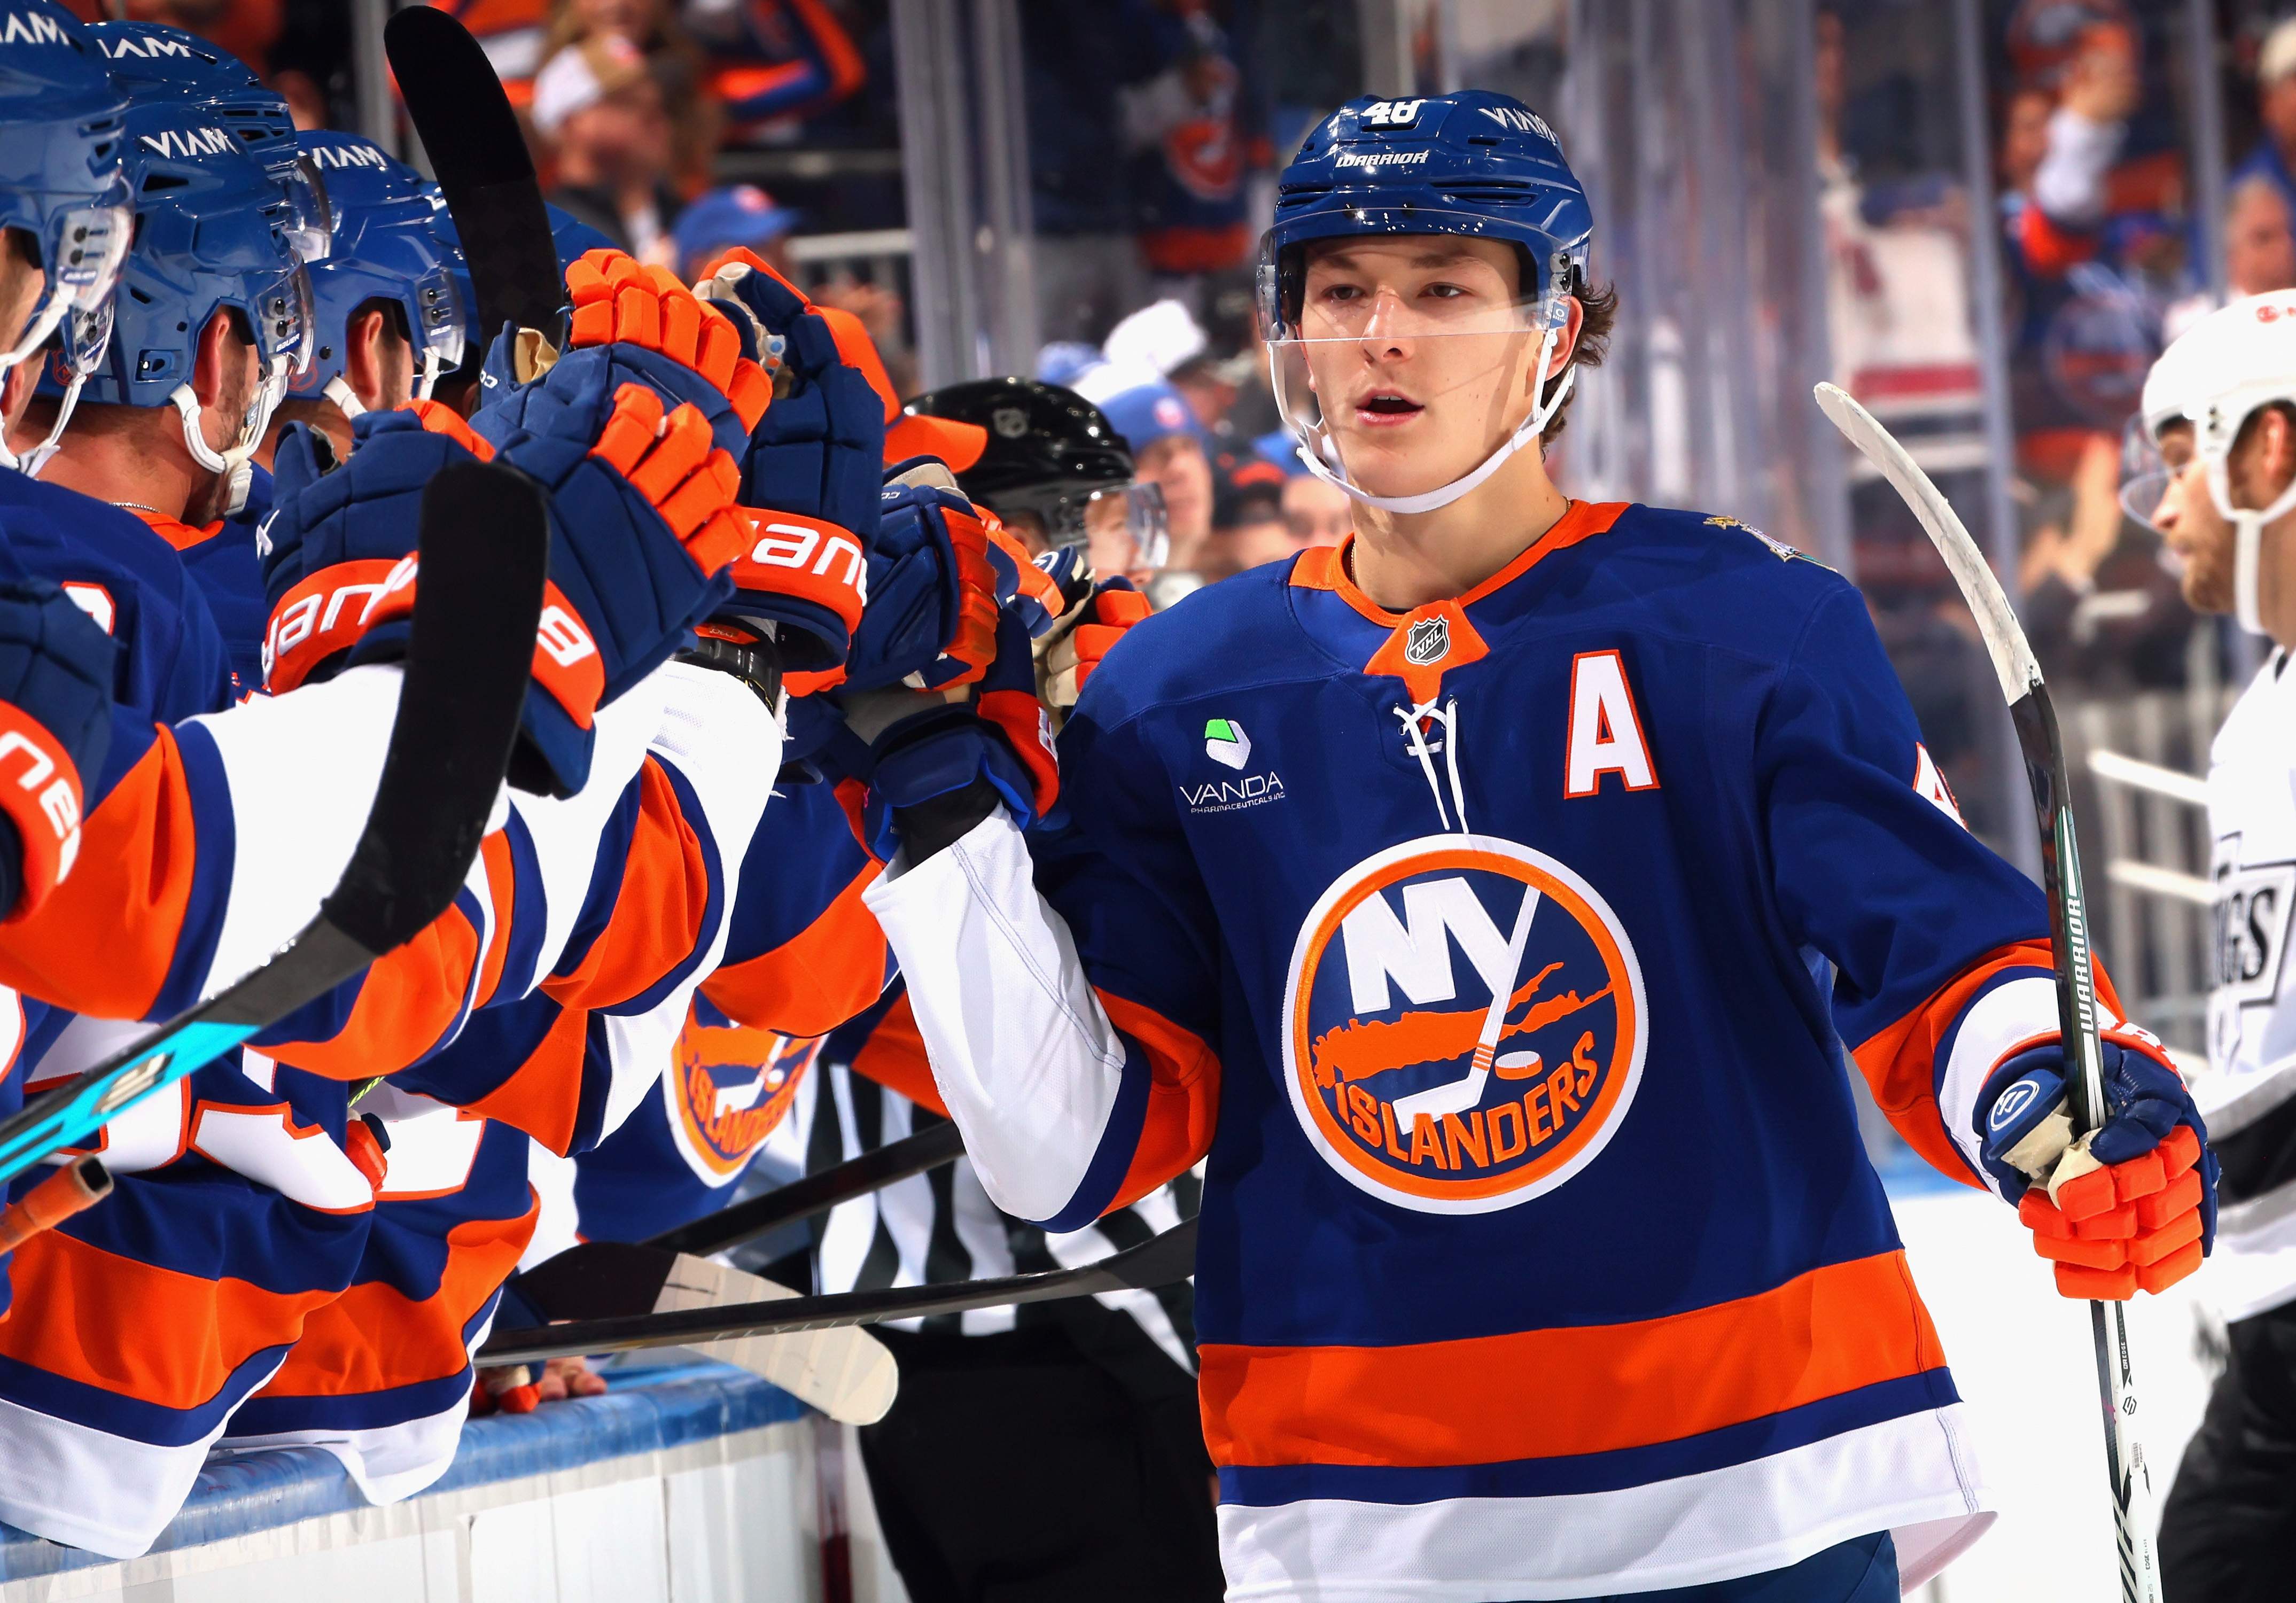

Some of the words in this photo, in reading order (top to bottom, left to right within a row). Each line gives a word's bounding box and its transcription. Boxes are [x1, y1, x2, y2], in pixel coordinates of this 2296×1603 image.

[0, 12, 70, 46] AM
[96, 37, 191, 59] IAM
[140, 128, 239, 159] VIAM
[1335, 150, 1430, 168] WARRIOR
[1415, 629, 1441, 658] NHL
[1565, 649, 1660, 799] A
[1179, 771, 1283, 805] VANDA
[1191, 796, 1273, 814] PHARMACEUTICALS
[1342, 877, 1541, 1045] NY
[2067, 898, 2094, 1031] WARRIOR
[1336, 1031, 1598, 1170] ISLANDERS
